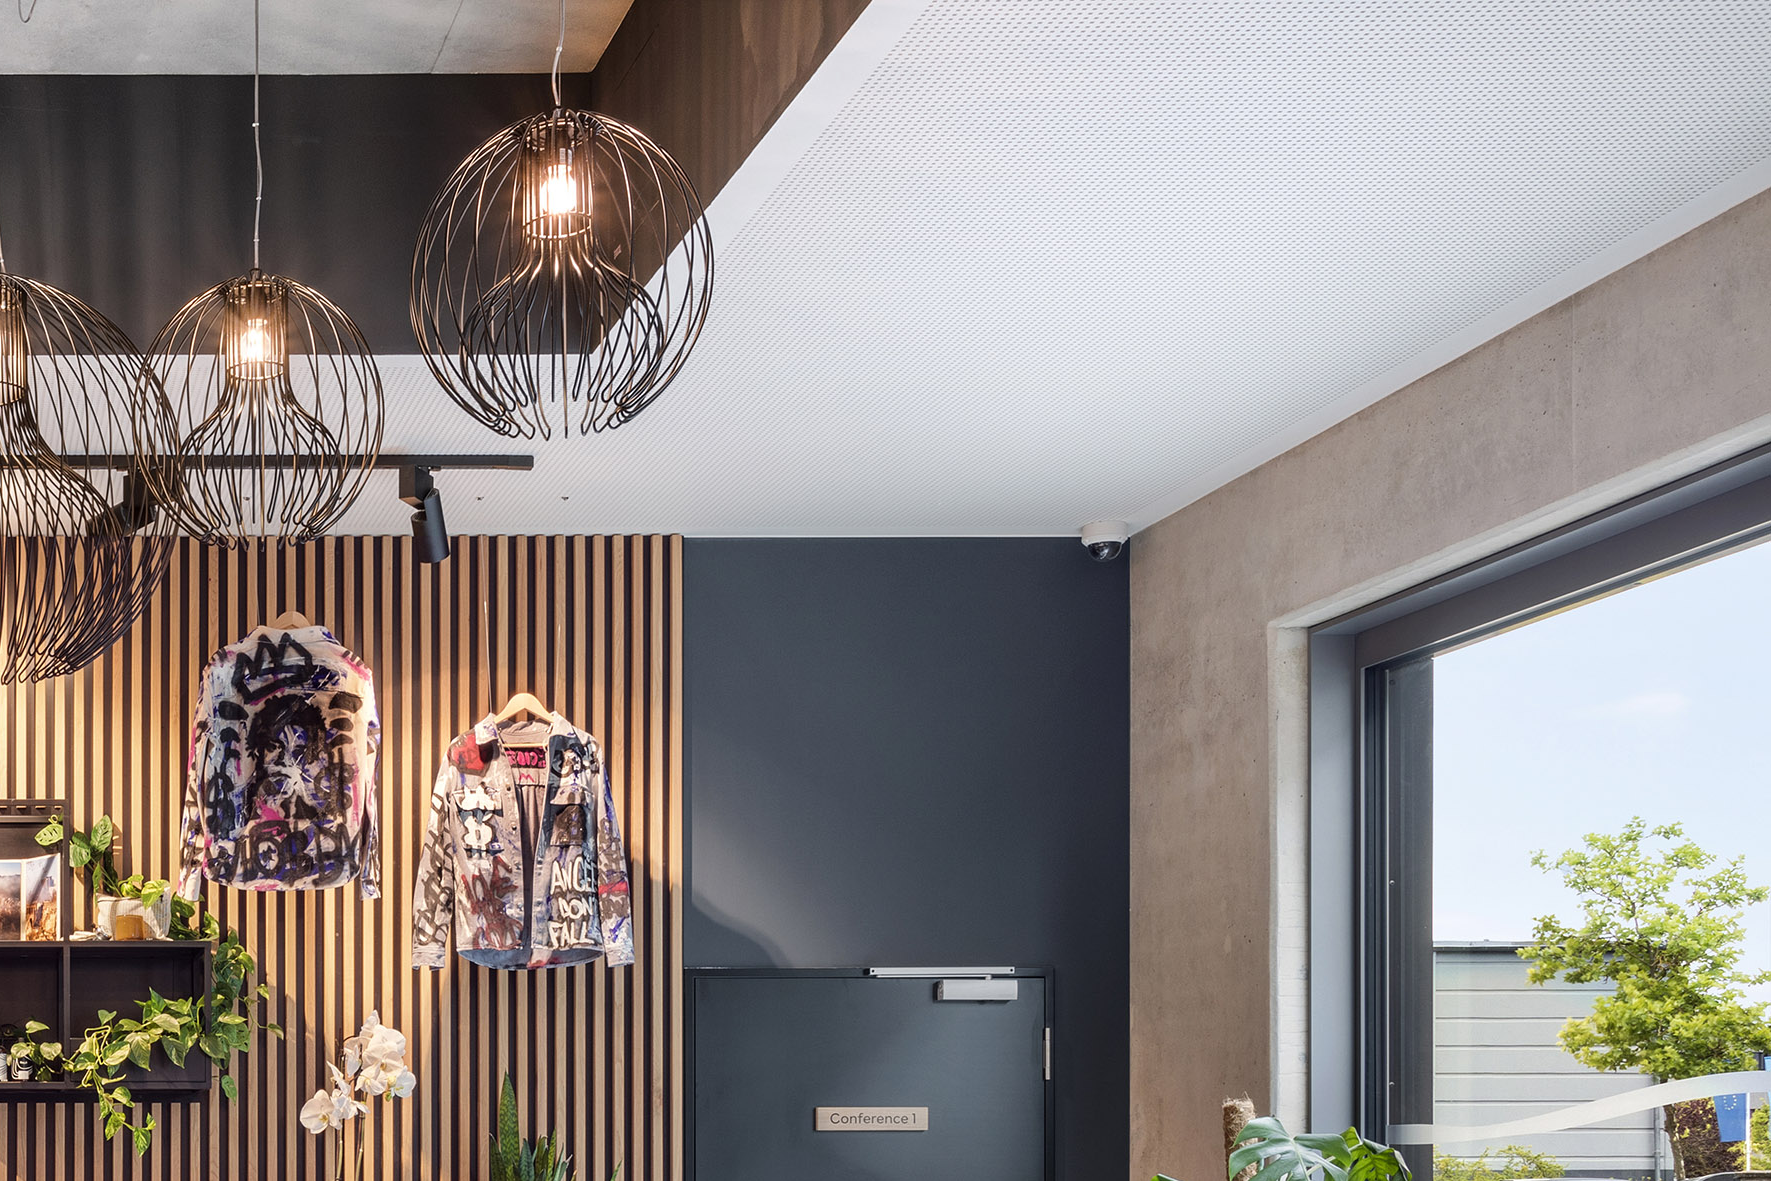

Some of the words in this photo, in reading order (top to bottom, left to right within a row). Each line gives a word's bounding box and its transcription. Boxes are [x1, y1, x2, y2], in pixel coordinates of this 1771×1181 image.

[548, 920, 595, 950] FALL
[830, 1113, 909, 1125] Conference
[912, 1113, 917, 1124] 1
